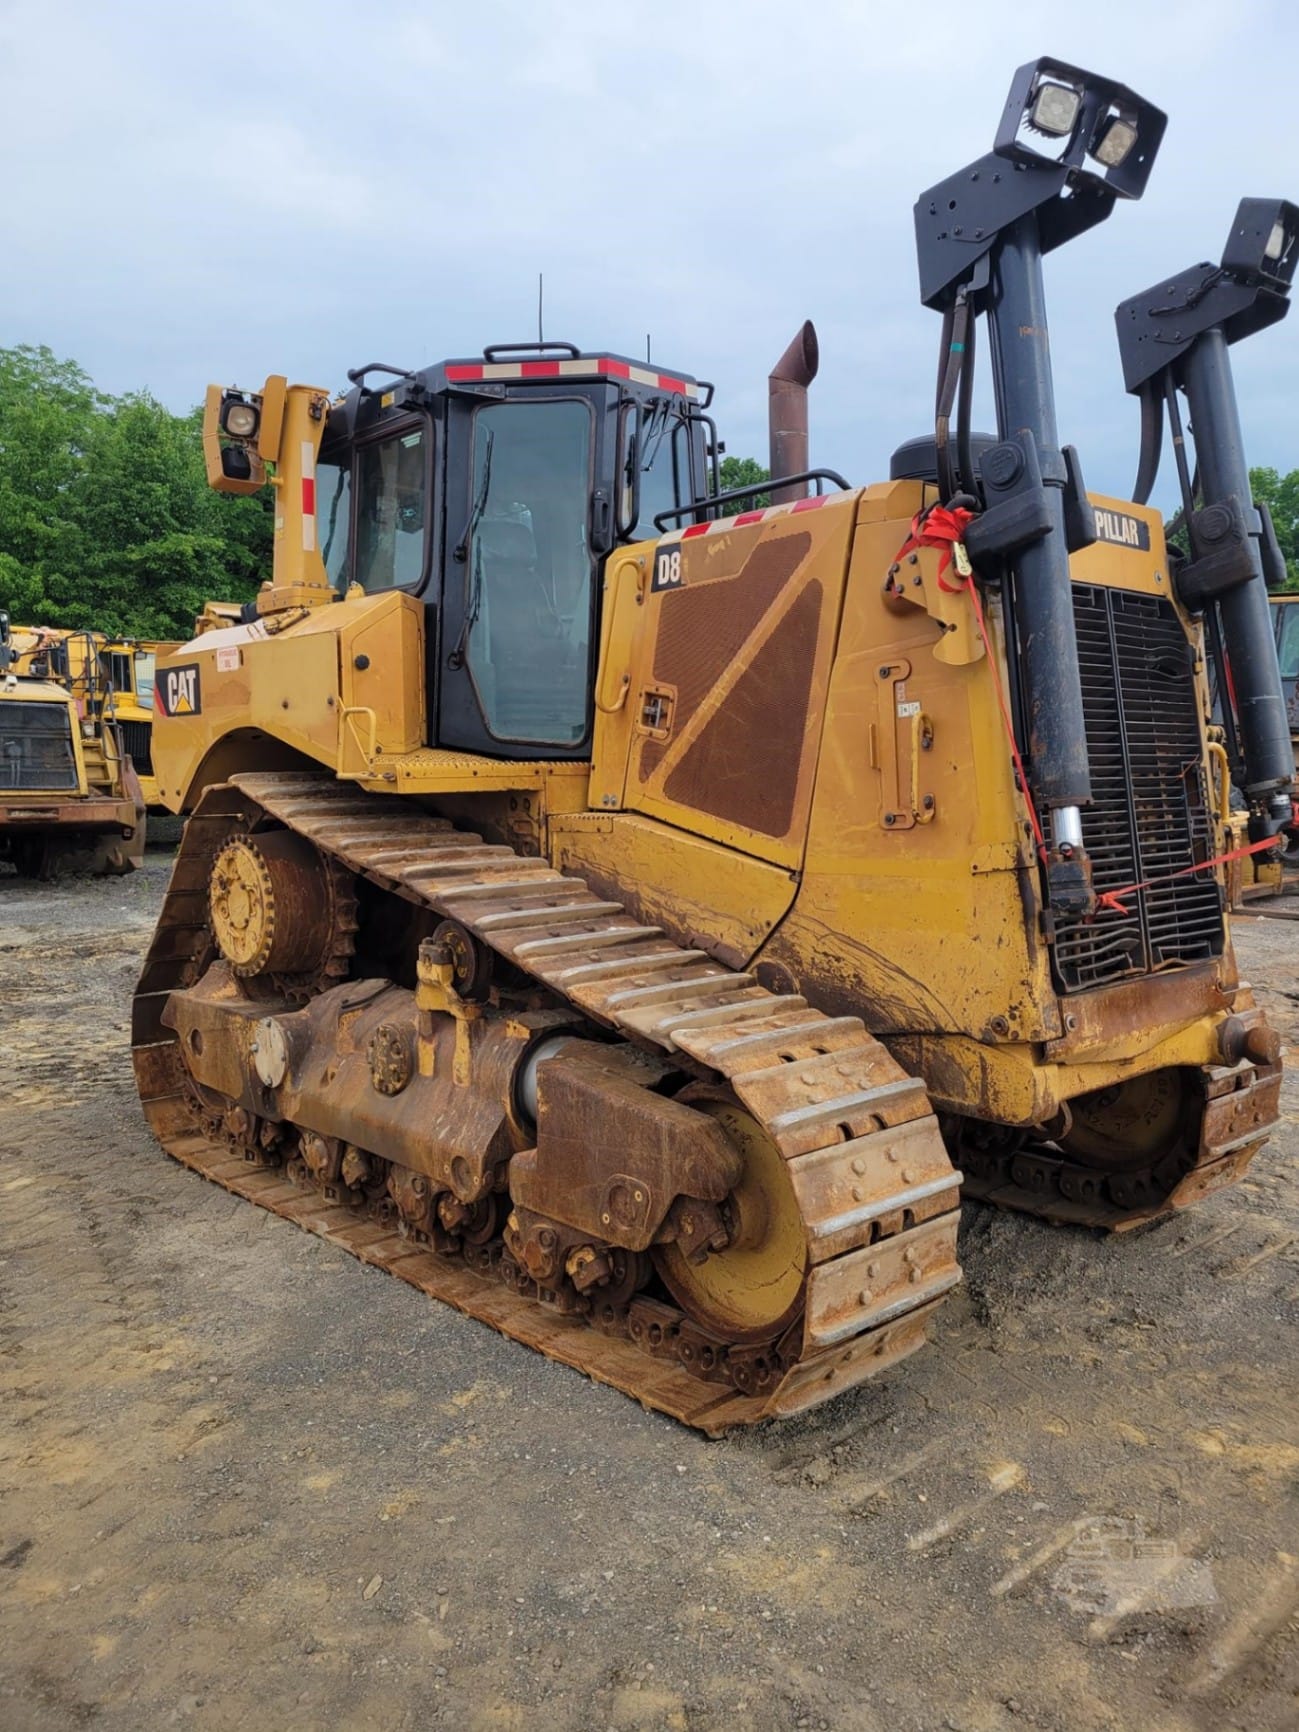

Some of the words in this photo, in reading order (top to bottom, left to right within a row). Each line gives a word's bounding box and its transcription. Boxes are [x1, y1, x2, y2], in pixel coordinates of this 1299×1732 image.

[1094, 510, 1139, 546] PILLAR
[658, 551, 681, 585] D8
[167, 669, 196, 713] CAT
